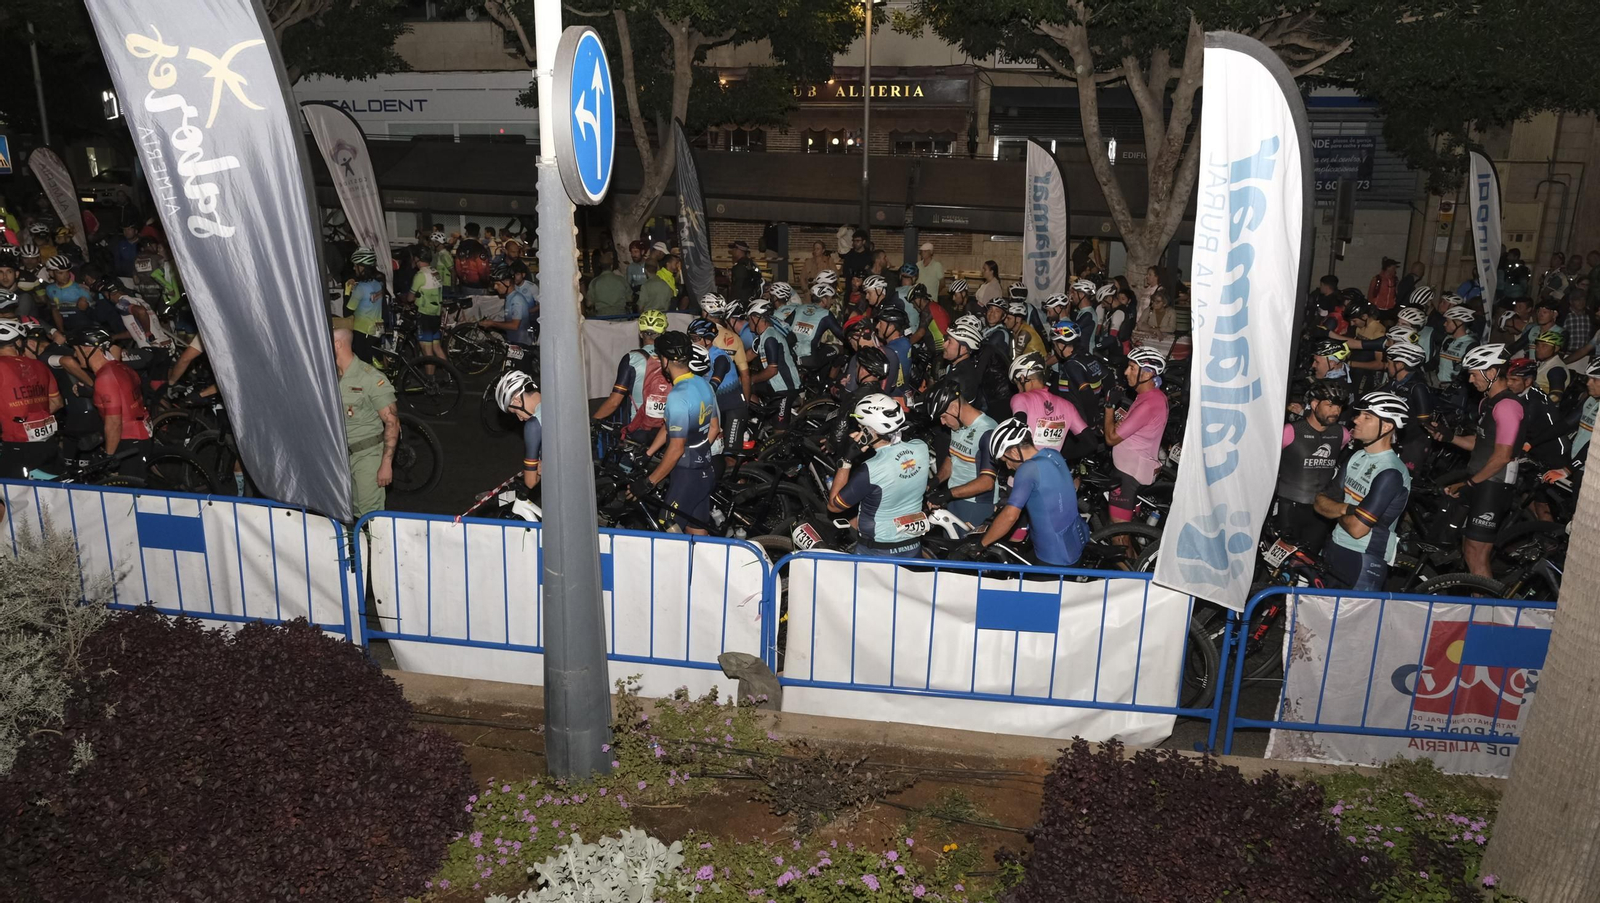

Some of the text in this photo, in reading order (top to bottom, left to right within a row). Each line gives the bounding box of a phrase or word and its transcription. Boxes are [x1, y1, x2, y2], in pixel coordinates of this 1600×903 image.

[793, 85, 817, 98] UB
[1311, 139, 1330, 149] NDE
[1043, 428, 1063, 439] 6142
[904, 520, 926, 533] 7379
[795, 528, 814, 550] 7379
